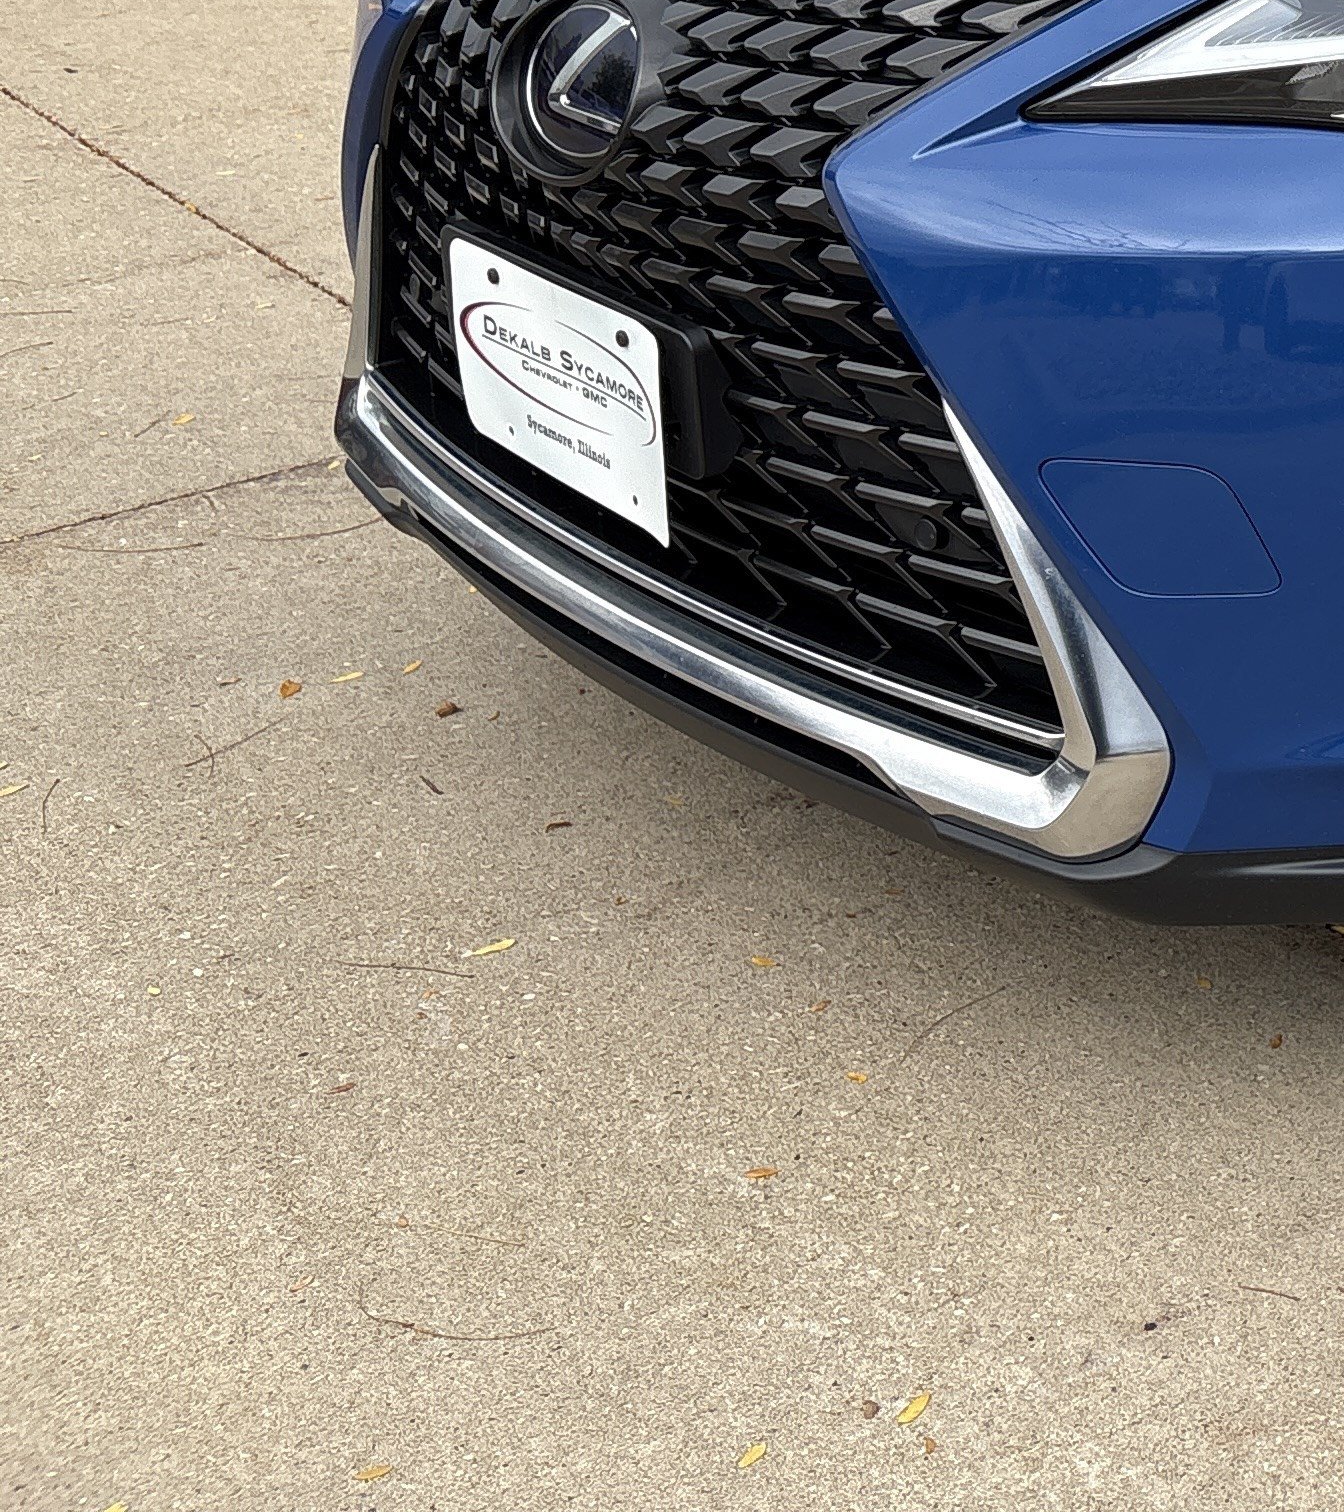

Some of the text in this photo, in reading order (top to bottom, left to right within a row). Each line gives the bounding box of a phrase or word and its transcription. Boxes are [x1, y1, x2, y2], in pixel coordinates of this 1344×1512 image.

[521, 359, 609, 409] CHEVROLET GMC
[559, 349, 645, 413] SYCAMORE
[526, 414, 611, 470] Sycamore, Illinois
